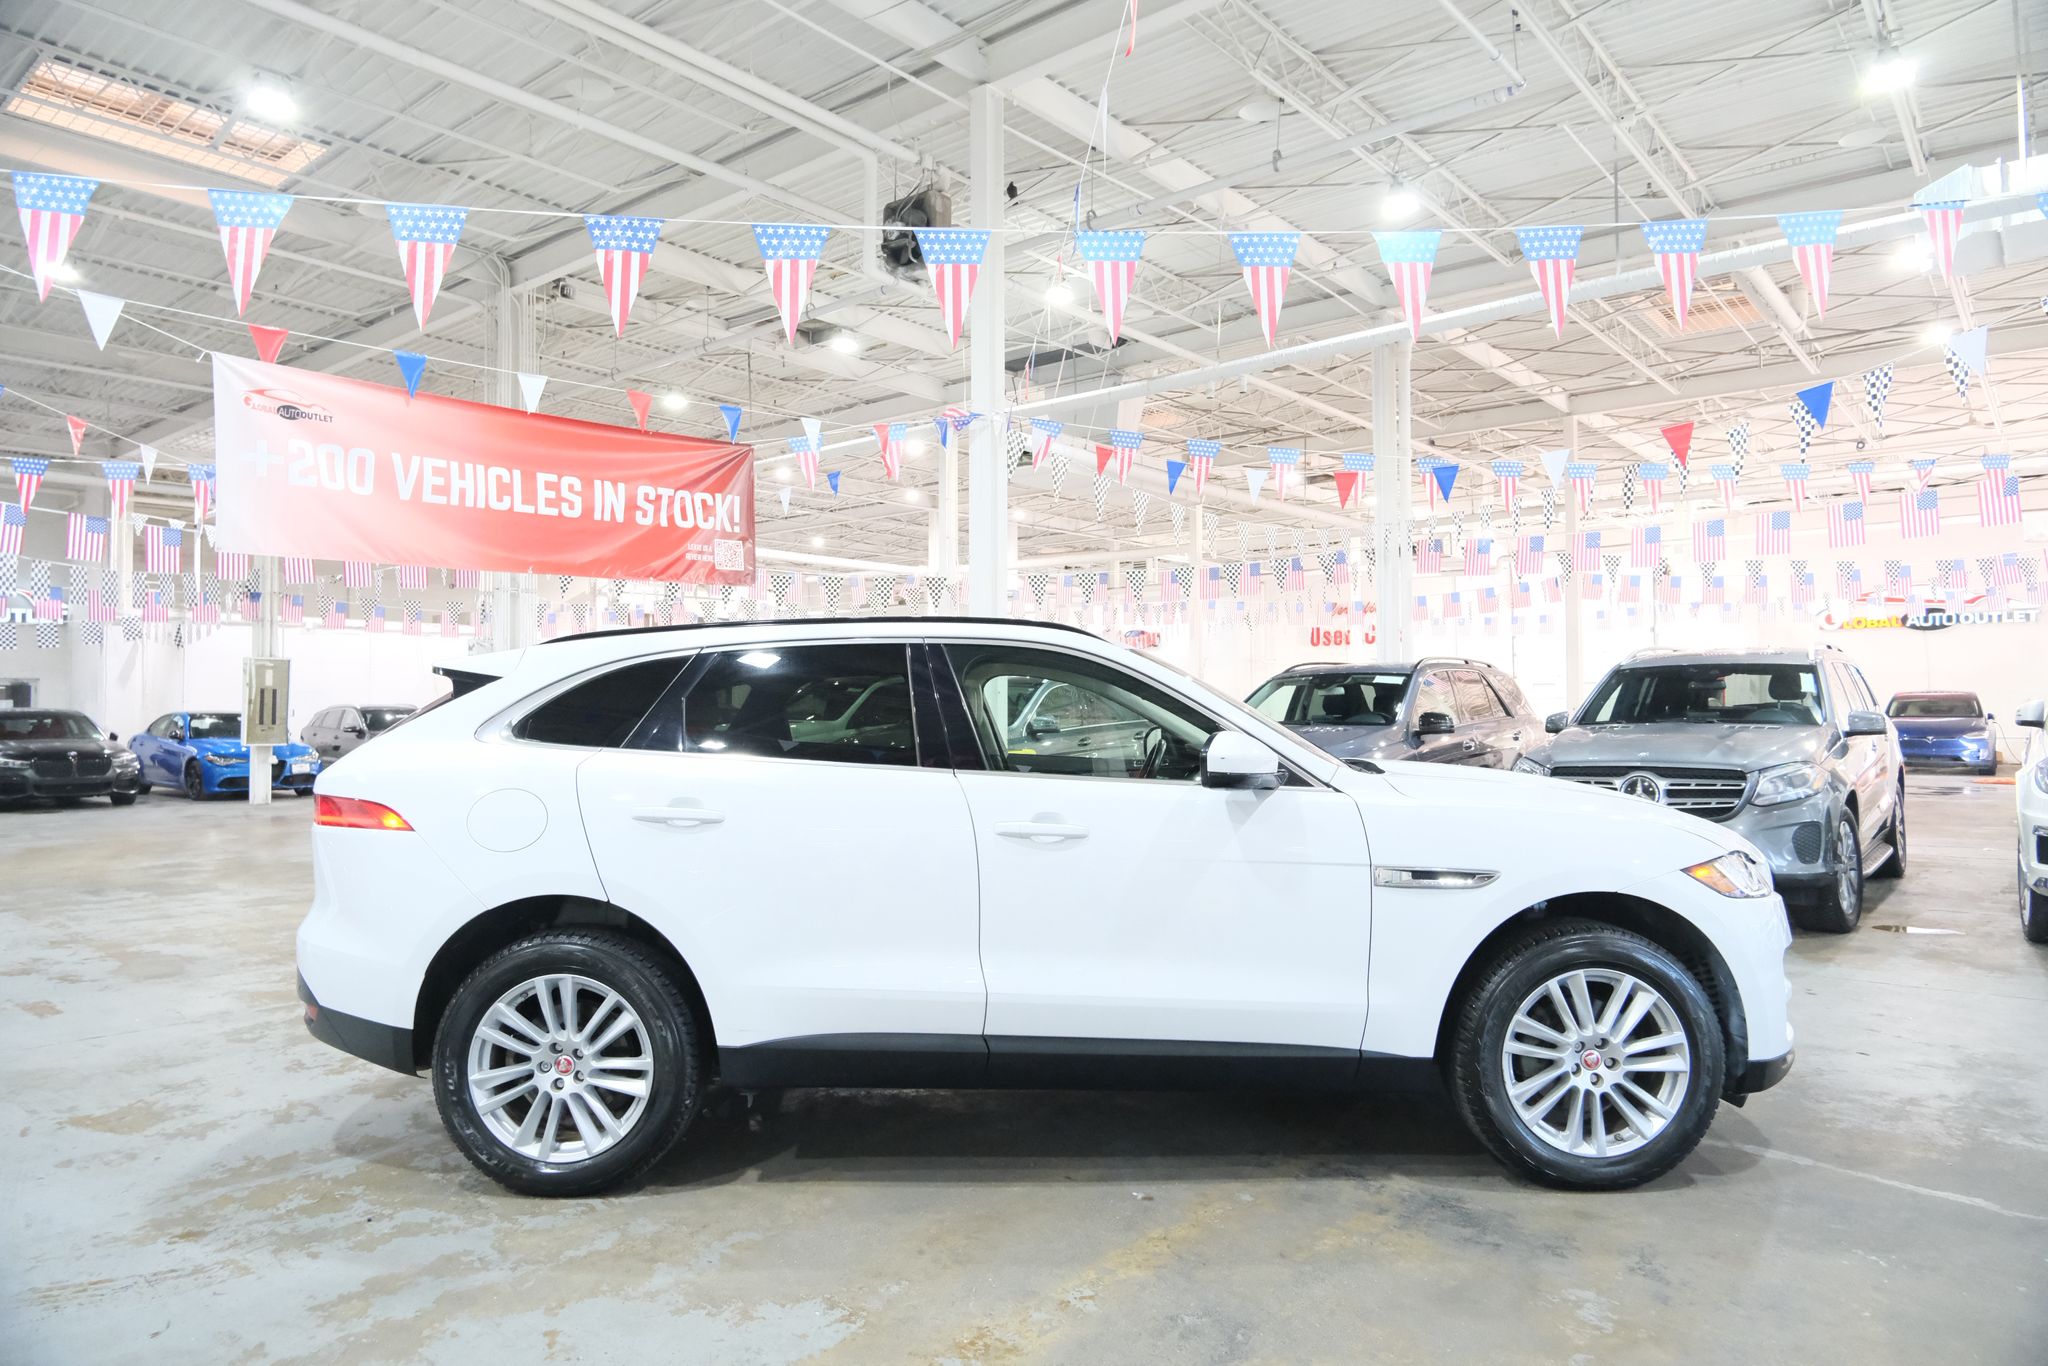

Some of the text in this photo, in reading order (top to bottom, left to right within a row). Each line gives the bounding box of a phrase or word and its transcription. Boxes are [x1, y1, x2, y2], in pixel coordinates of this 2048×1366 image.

[240, 437, 741, 533] +200 VEHICLES IN STOCK!
[1905, 612, 1957, 628] AUTO
[1959, 609, 2040, 625] OUTLET
